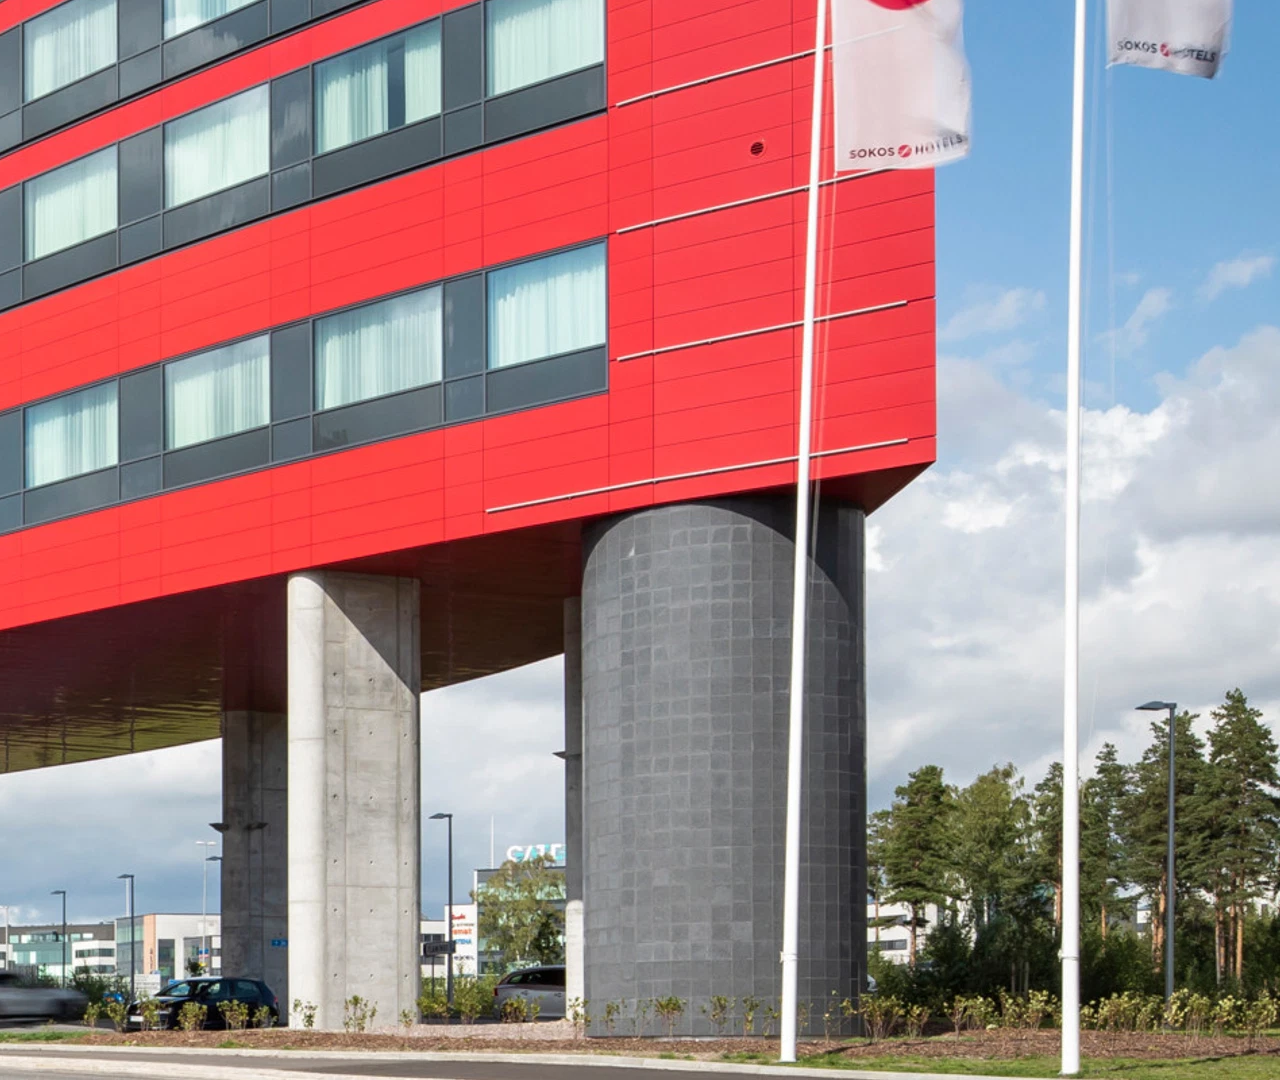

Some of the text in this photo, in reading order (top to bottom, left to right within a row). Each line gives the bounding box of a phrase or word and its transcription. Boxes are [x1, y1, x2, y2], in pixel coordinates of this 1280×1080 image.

[1117, 40, 1216, 62] SOKOS TELS
[849, 134, 963, 159] SOKOS HOTELS
